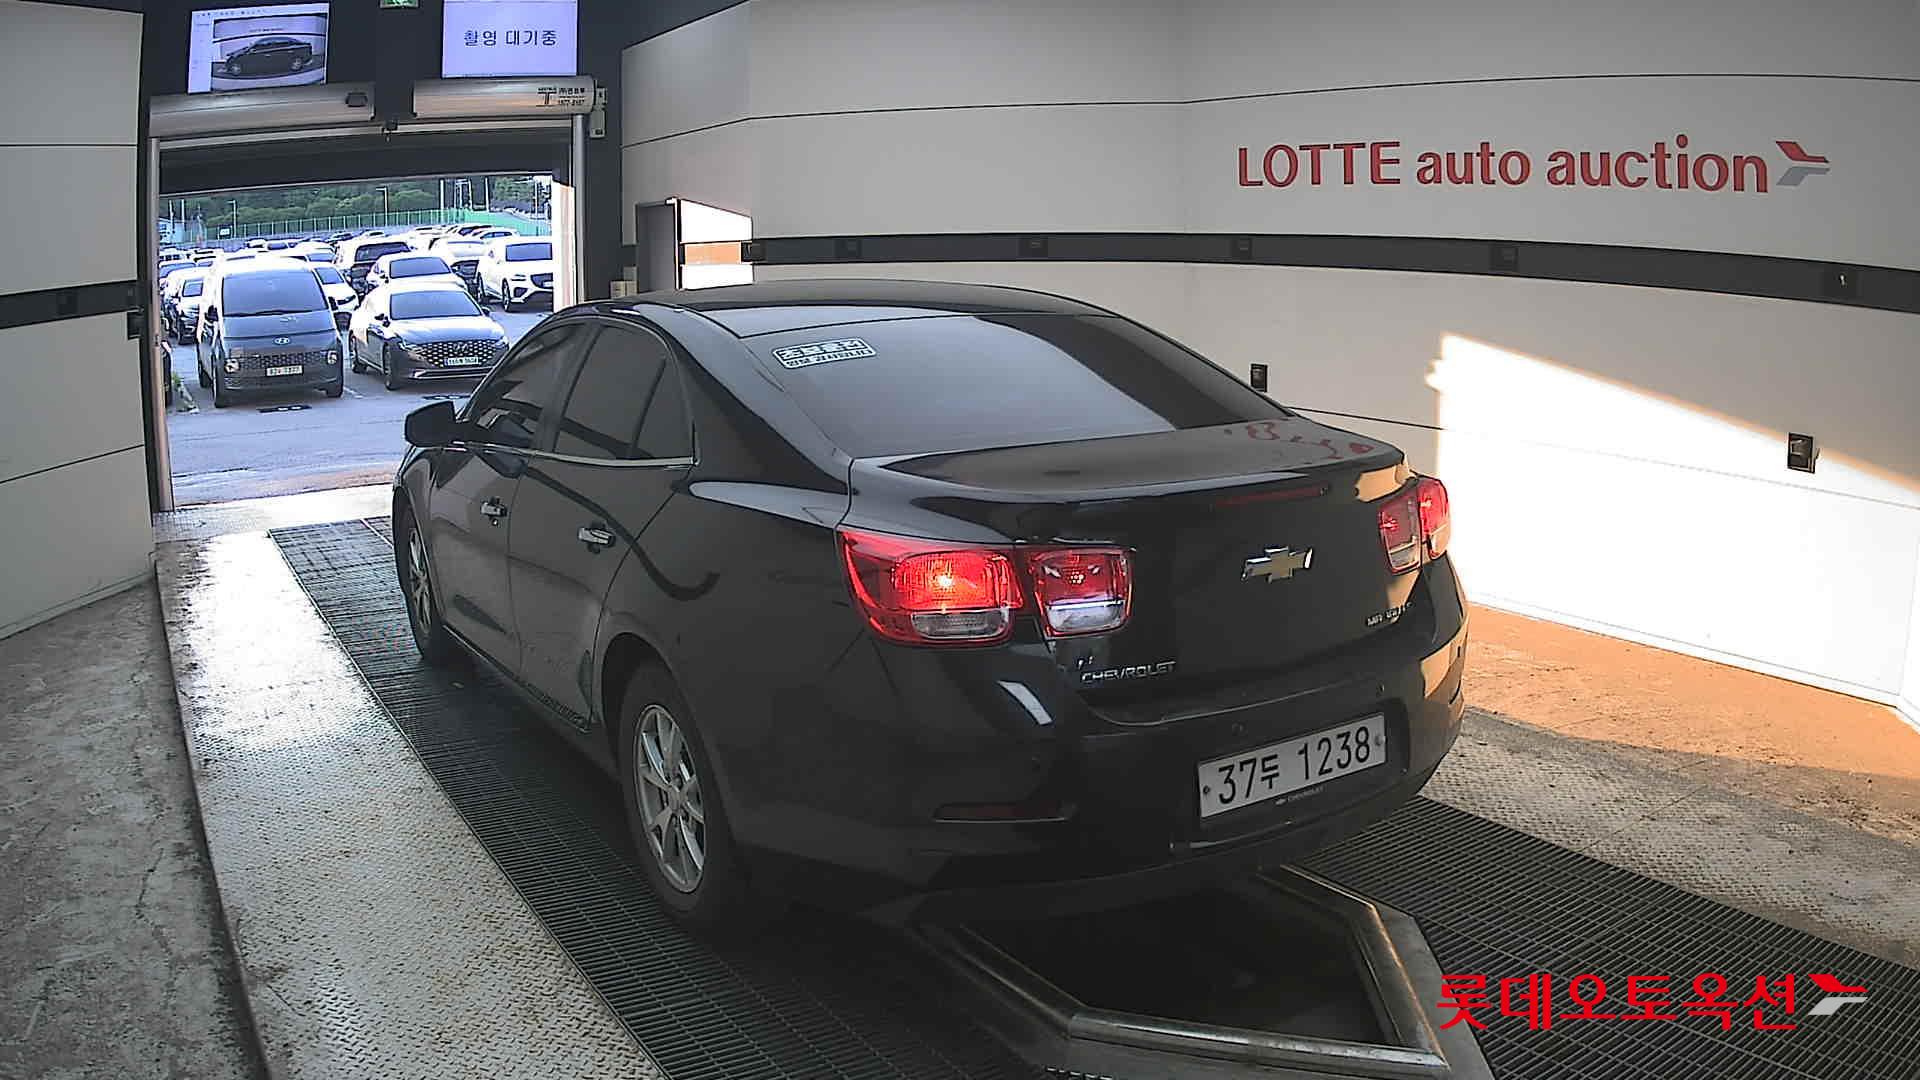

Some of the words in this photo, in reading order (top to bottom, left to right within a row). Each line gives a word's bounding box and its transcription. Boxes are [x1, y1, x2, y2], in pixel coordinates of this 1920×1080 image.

[505, 30, 557, 46] 대기중
[1238, 141, 1400, 187] LOTTE
[1416, 141, 1531, 186] auto
[1546, 134, 1769, 193] auction
[1081, 660, 1177, 684] CHEVROLET
[1218, 754, 1280, 804] 37두
[1297, 726, 1371, 781] 1238
